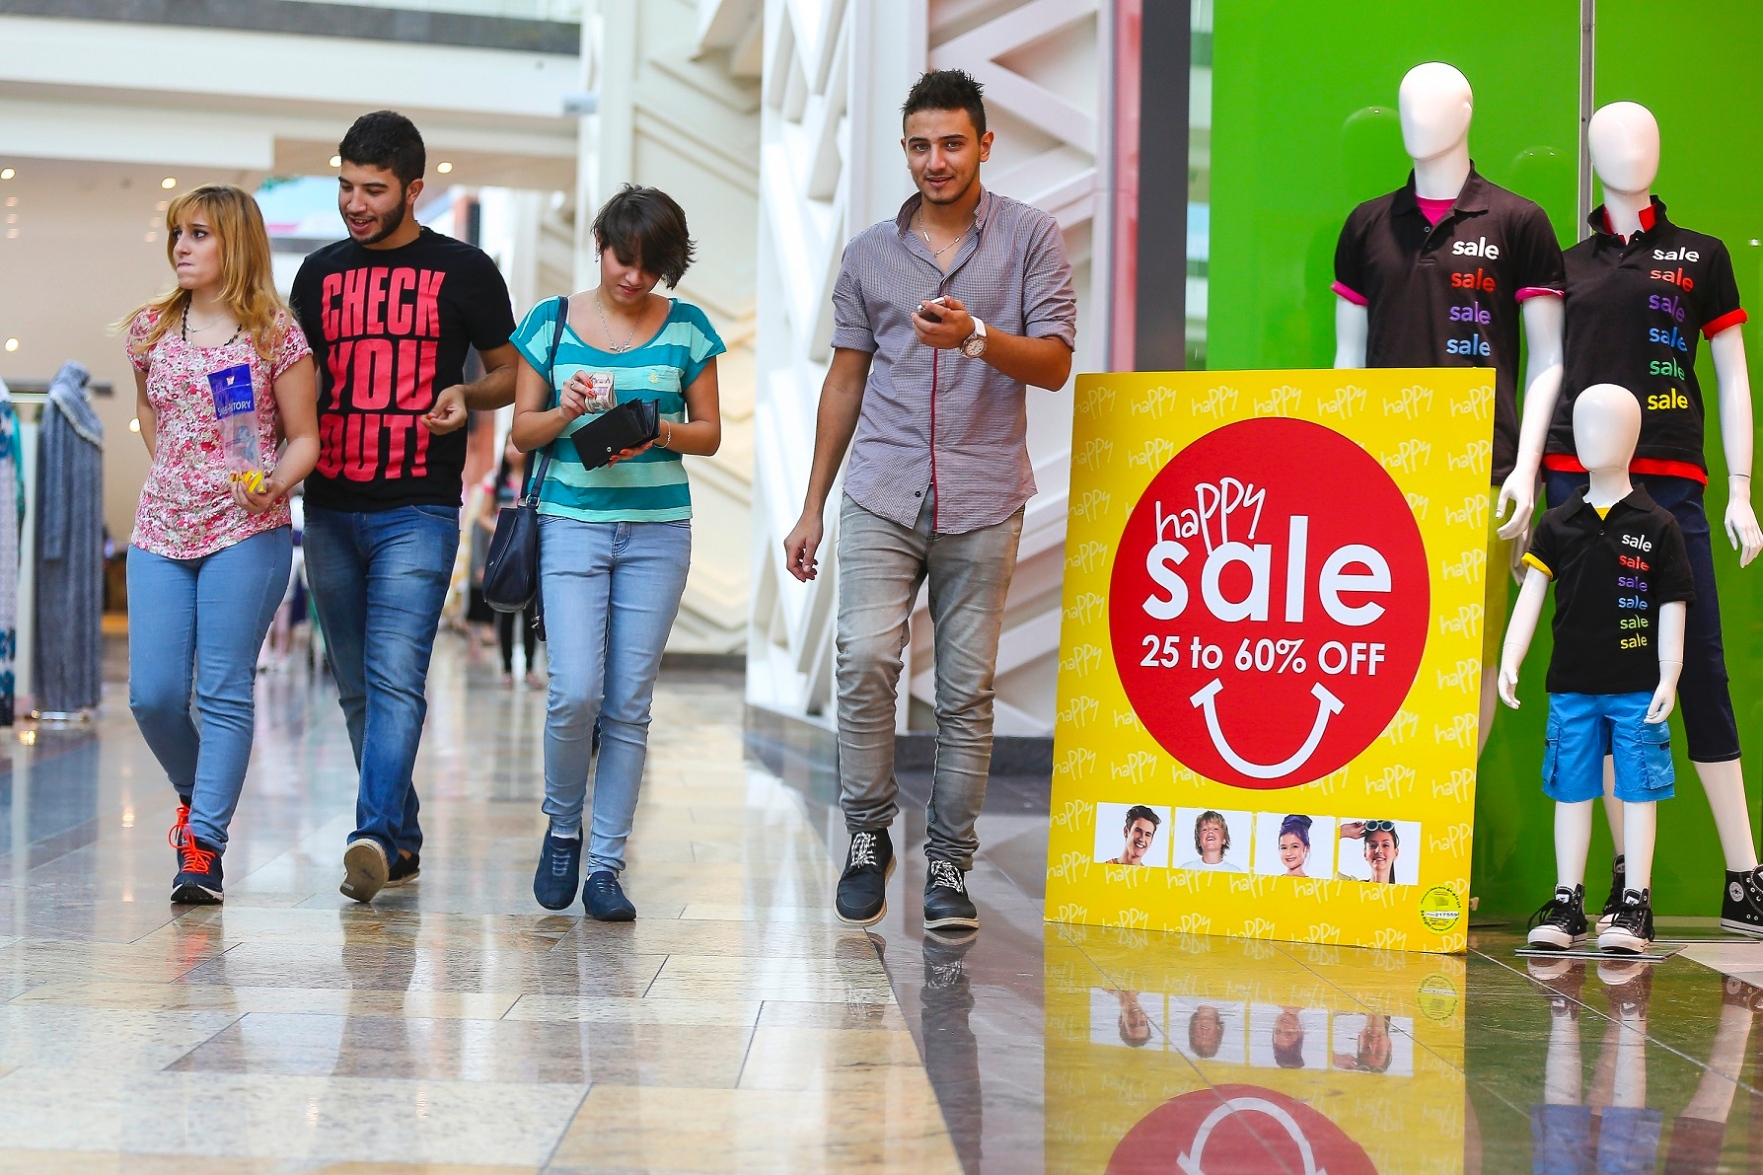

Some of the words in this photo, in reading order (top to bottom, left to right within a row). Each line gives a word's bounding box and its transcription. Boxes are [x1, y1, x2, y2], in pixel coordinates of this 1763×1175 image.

[1452, 235, 1500, 261] sale
[1652, 246, 1700, 263] sale
[1450, 268, 1496, 293] sale
[1650, 266, 1694, 292] sale
[321, 266, 446, 342] CHECK
[1449, 301, 1492, 326] sale
[1648, 294, 1686, 323] sale
[1445, 333, 1492, 358] sale
[1648, 326, 1688, 353] sale
[327, 339, 438, 411] YOU
[1649, 357, 1686, 382] sale
[1131, 385, 1177, 420] happy
[1191, 385, 1239, 420] happy
[1253, 385, 1302, 417] happy
[1317, 385, 1367, 420] happy
[1383, 385, 1433, 420] happy
[1647, 387, 1688, 411] sale
[317, 414, 431, 483] OUT!
[1128, 437, 1174, 472] happy
[1380, 439, 1431, 474] happy
[1154, 475, 1267, 556] happy
[1621, 532, 1652, 553] sale
[1141, 514, 1392, 627] sale
[1619, 554, 1649, 571] sale
[1617, 574, 1648, 592] sale
[1618, 595, 1648, 610] sale
[1620, 614, 1649, 630] sale
[1620, 633, 1648, 650] sale
[1140, 634, 1180, 668] 25
[1190, 635, 1223, 670] to
[1235, 638, 1307, 675] 60%
[1317, 640, 1385, 676] OFF
[1111, 750, 1157, 785] happy
[1365, 764, 1416, 800] happy
